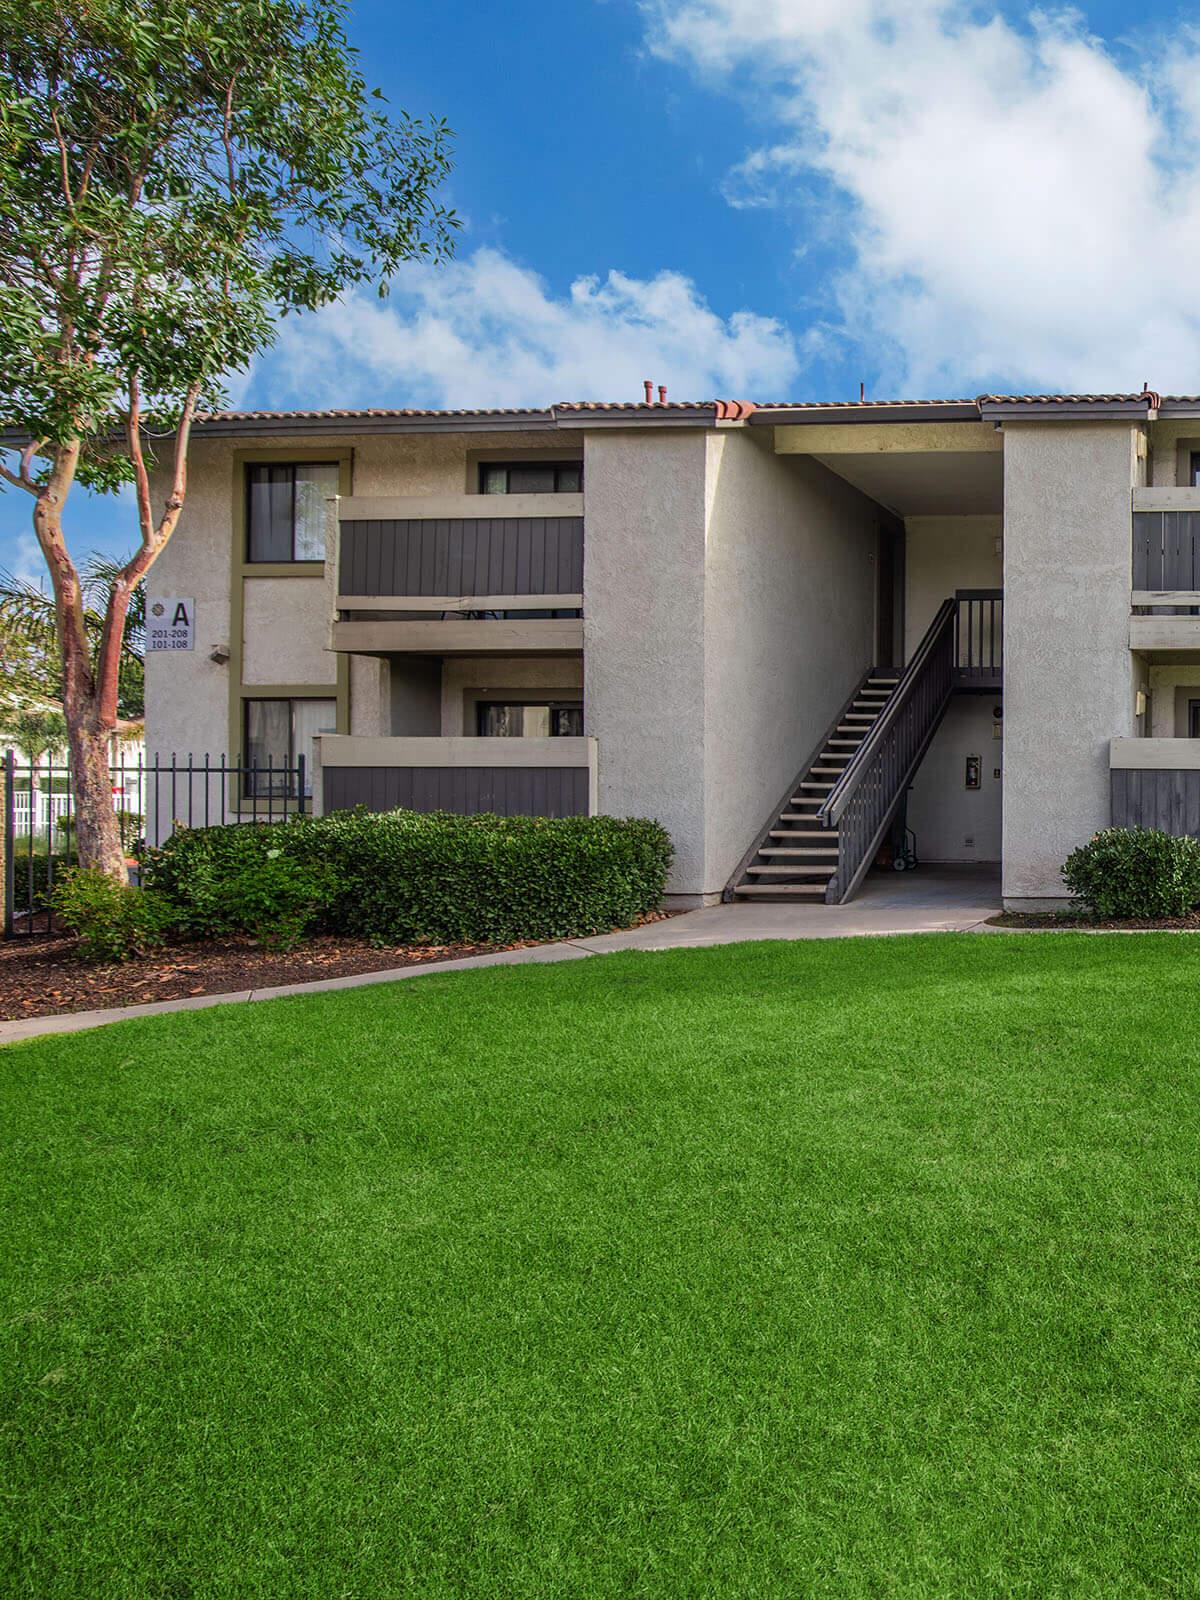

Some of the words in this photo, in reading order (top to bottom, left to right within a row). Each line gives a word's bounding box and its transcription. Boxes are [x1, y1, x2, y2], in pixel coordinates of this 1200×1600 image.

[172, 602, 189, 626] A
[151, 630, 188, 638] 201-208
[152, 640, 188, 648] 101-108
